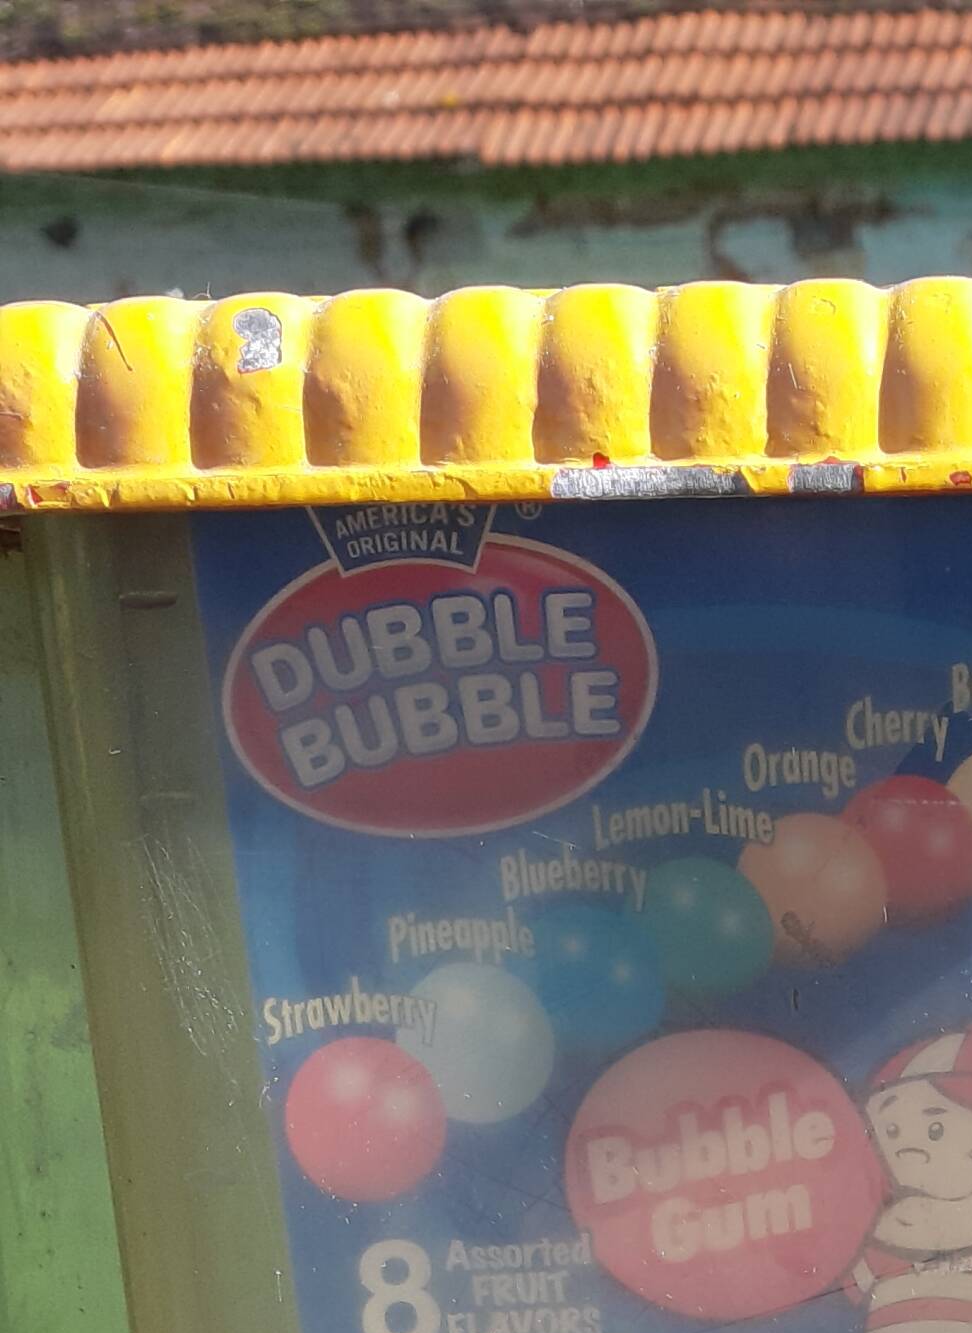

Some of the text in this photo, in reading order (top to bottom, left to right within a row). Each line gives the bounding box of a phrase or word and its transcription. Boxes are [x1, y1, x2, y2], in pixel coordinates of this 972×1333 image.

[336, 501, 476, 540] AMERICA'S
[346, 529, 465, 559] ORIGINAL
[251, 590, 597, 713] DUBBLE
[281, 669, 621, 789] BUBBLE
[845, 697, 949, 762] Cherry
[743, 742, 857, 797] Orange
[592, 788, 775, 851] Lemon-Lime
[500, 847, 647, 912] Blueberry
[387, 906, 536, 964] Pineapple
[263, 975, 438, 1048] Strawberry
[587, 1090, 836, 1206] Bubble
[445, 1232, 592, 1272] Assorted
[650, 1183, 814, 1264] Gum
[472, 1269, 571, 1307] FRUIT
